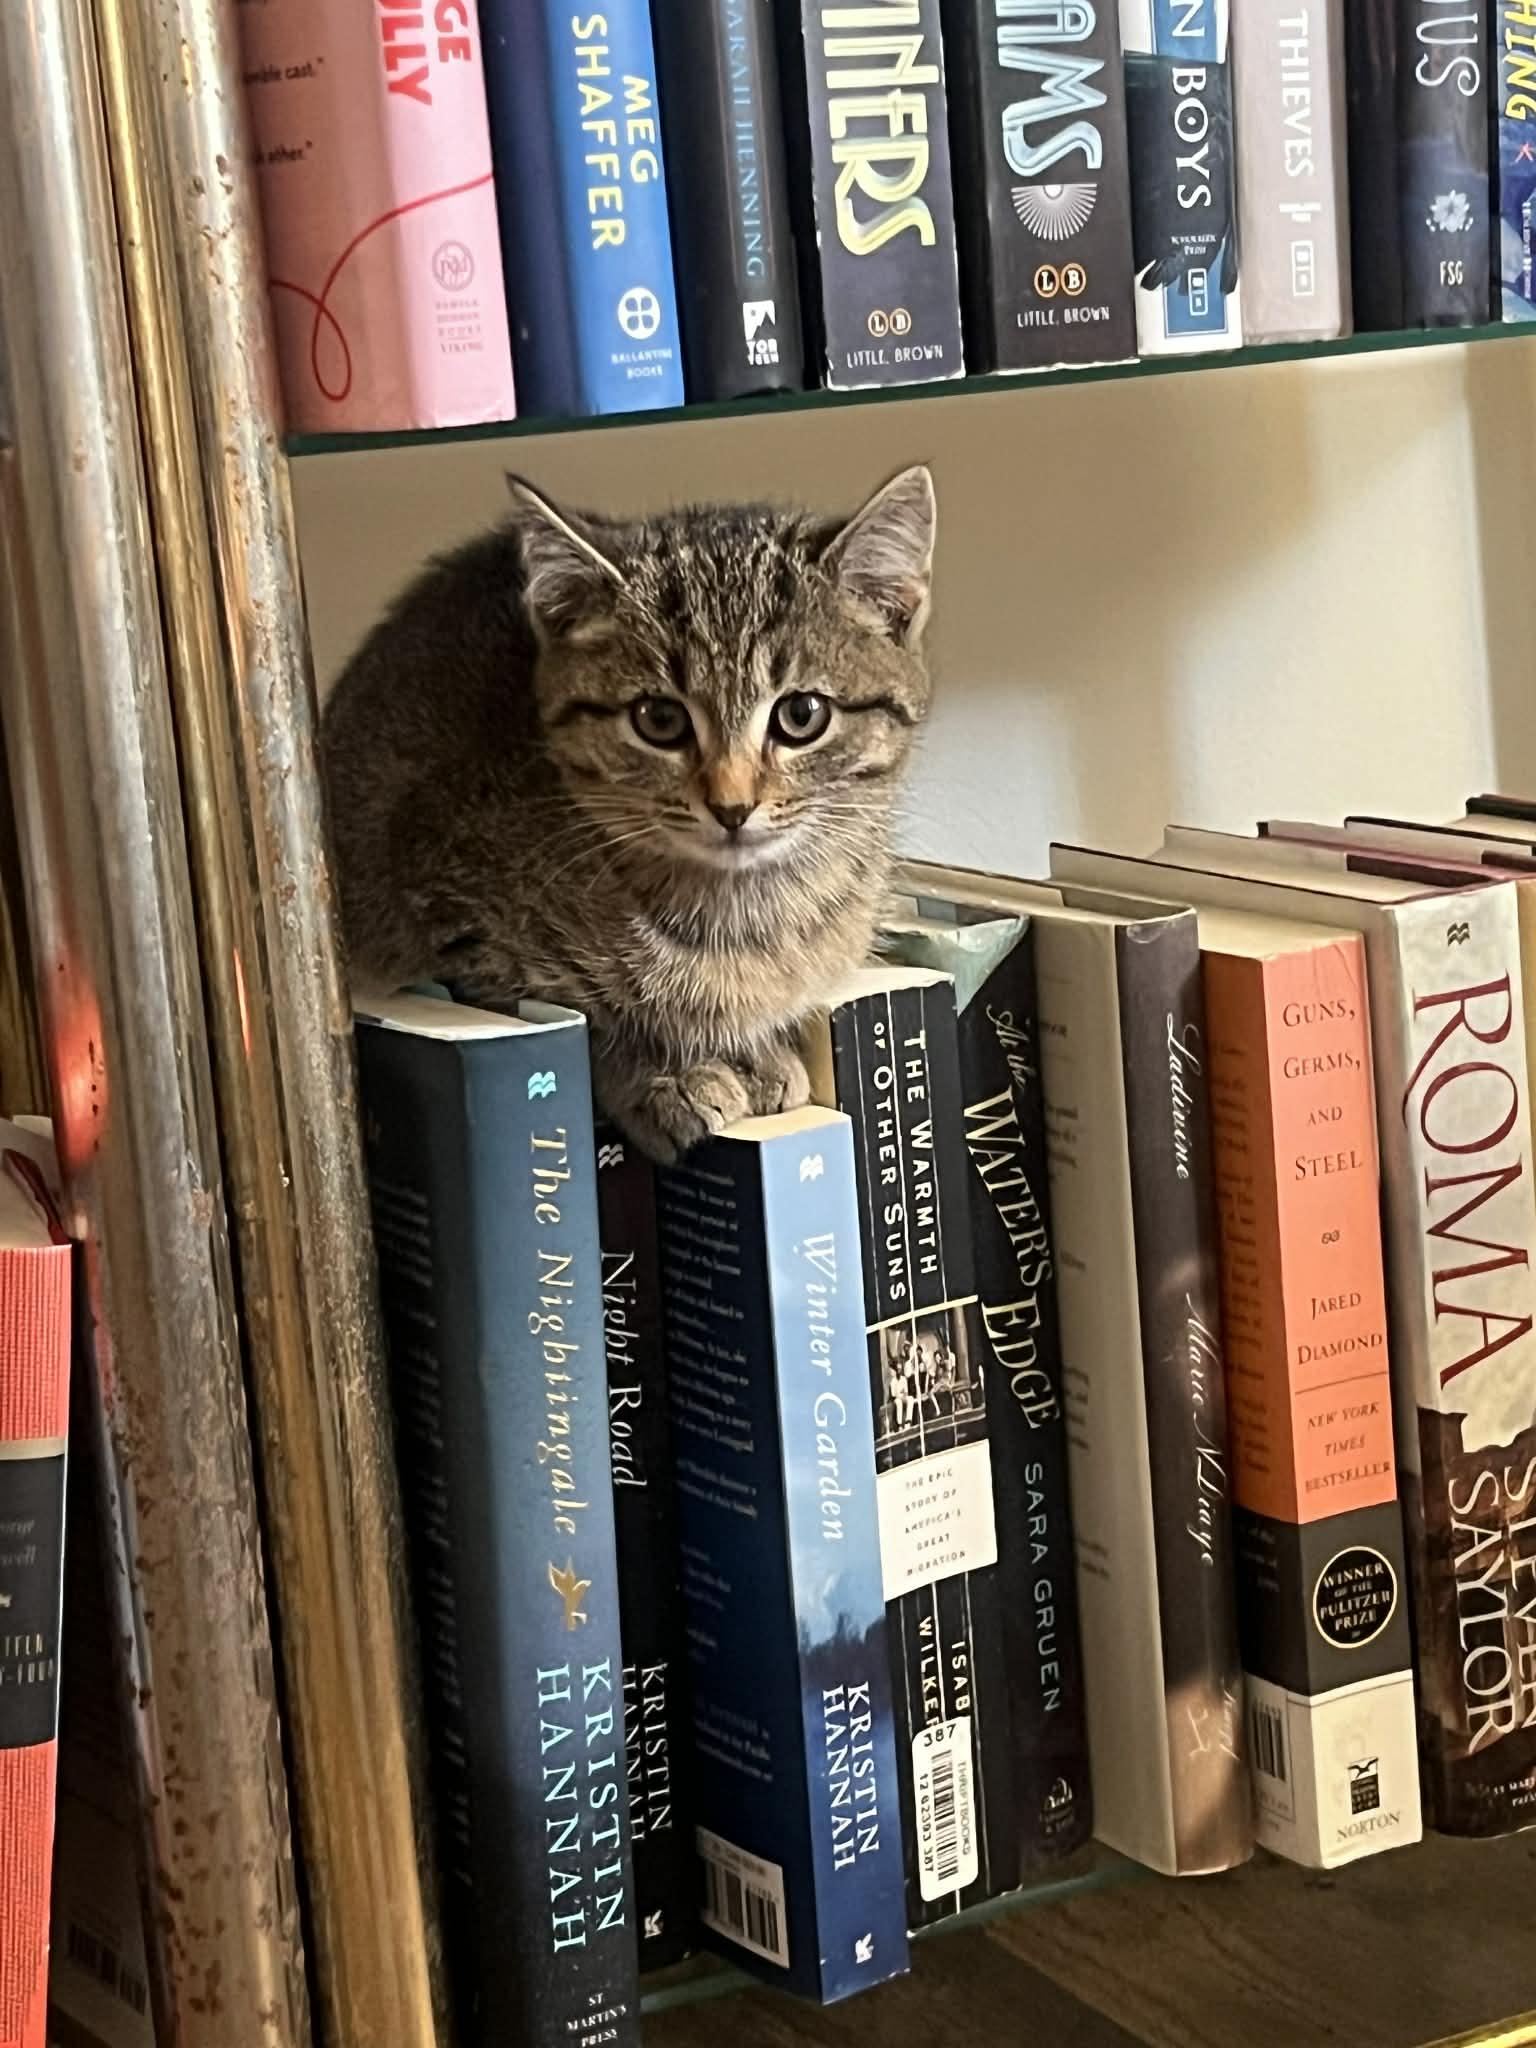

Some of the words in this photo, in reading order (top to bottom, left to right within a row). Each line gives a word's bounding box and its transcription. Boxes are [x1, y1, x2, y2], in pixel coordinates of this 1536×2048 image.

[727, 0, 751, 105] ARAH
[1279, 10, 1315, 178] THIEVES
[1415, 0, 1480, 97] US
[571, 13, 627, 251] SHAFFER
[622, 75, 660, 184] MEG
[821, 0, 940, 256] INERS
[1171, 66, 1213, 210] BOYS
[735, 119, 767, 278] HENNING
[1064, 305, 1111, 324] BROWN
[1440, 260, 1464, 287] FSG
[626, 364, 663, 379] BOOKS
[895, 344, 944, 365] BROWN
[873, 1021, 886, 1050] OF
[1283, 1000, 1356, 1028] GUNS,
[903, 1030, 926, 1103] THE
[1283, 1051, 1361, 1080] GERMS,
[873, 1064, 897, 1186] OTHER
[1294, 1150, 1364, 1181] STEEL
[1307, 1105, 1344, 1127] AND
[529, 1126, 572, 1225] The
[910, 1119, 938, 1276] WARMTH
[963, 1084, 1052, 1288] WATER'S
[1401, 968, 1534, 1391] ROMA
[882, 1202, 907, 1302] SUNS
[600, 1249, 641, 1366] Night
[793, 1231, 838, 1377] Winter
[1296, 1333, 1384, 1366] DIAMOND
[1311, 1292, 1362, 1321] JARED
[528, 1249, 589, 1535] Nightingale
[981, 1293, 1060, 1430] EDGE
[608, 1383, 648, 1487] Road
[1307, 1409, 1338, 1430] NEW
[1342, 1401, 1380, 1423] YORK
[1324, 1434, 1367, 1457] TIMES
[813, 1391, 852, 1541] Garden
[928, 1467, 954, 1484] EPIC
[1025, 1462, 1050, 1565] SARA
[1305, 1461, 1391, 1493] BESTSELLER
[916, 1532, 951, 1551] GREAT
[1323, 1562, 1385, 1589] WINNER
[1033, 1578, 1061, 1713] GRUEN
[1320, 1590, 1391, 1621] PULITZER
[1335, 1609, 1377, 1631] PRIZE
[1448, 1469, 1516, 1756] SAYLOR
[641, 1662, 673, 1832] KRISTIN
[822, 1684, 856, 1872] HANNAH
[848, 1680, 880, 1855] KRISTIN
[919, 1773, 929, 1791] 12
[924, 1723, 957, 1748] 387
[536, 1663, 587, 1954] HANNAH
[582, 1657, 625, 1932] KRISTIN
[1336, 1810, 1402, 1841] NORTON
